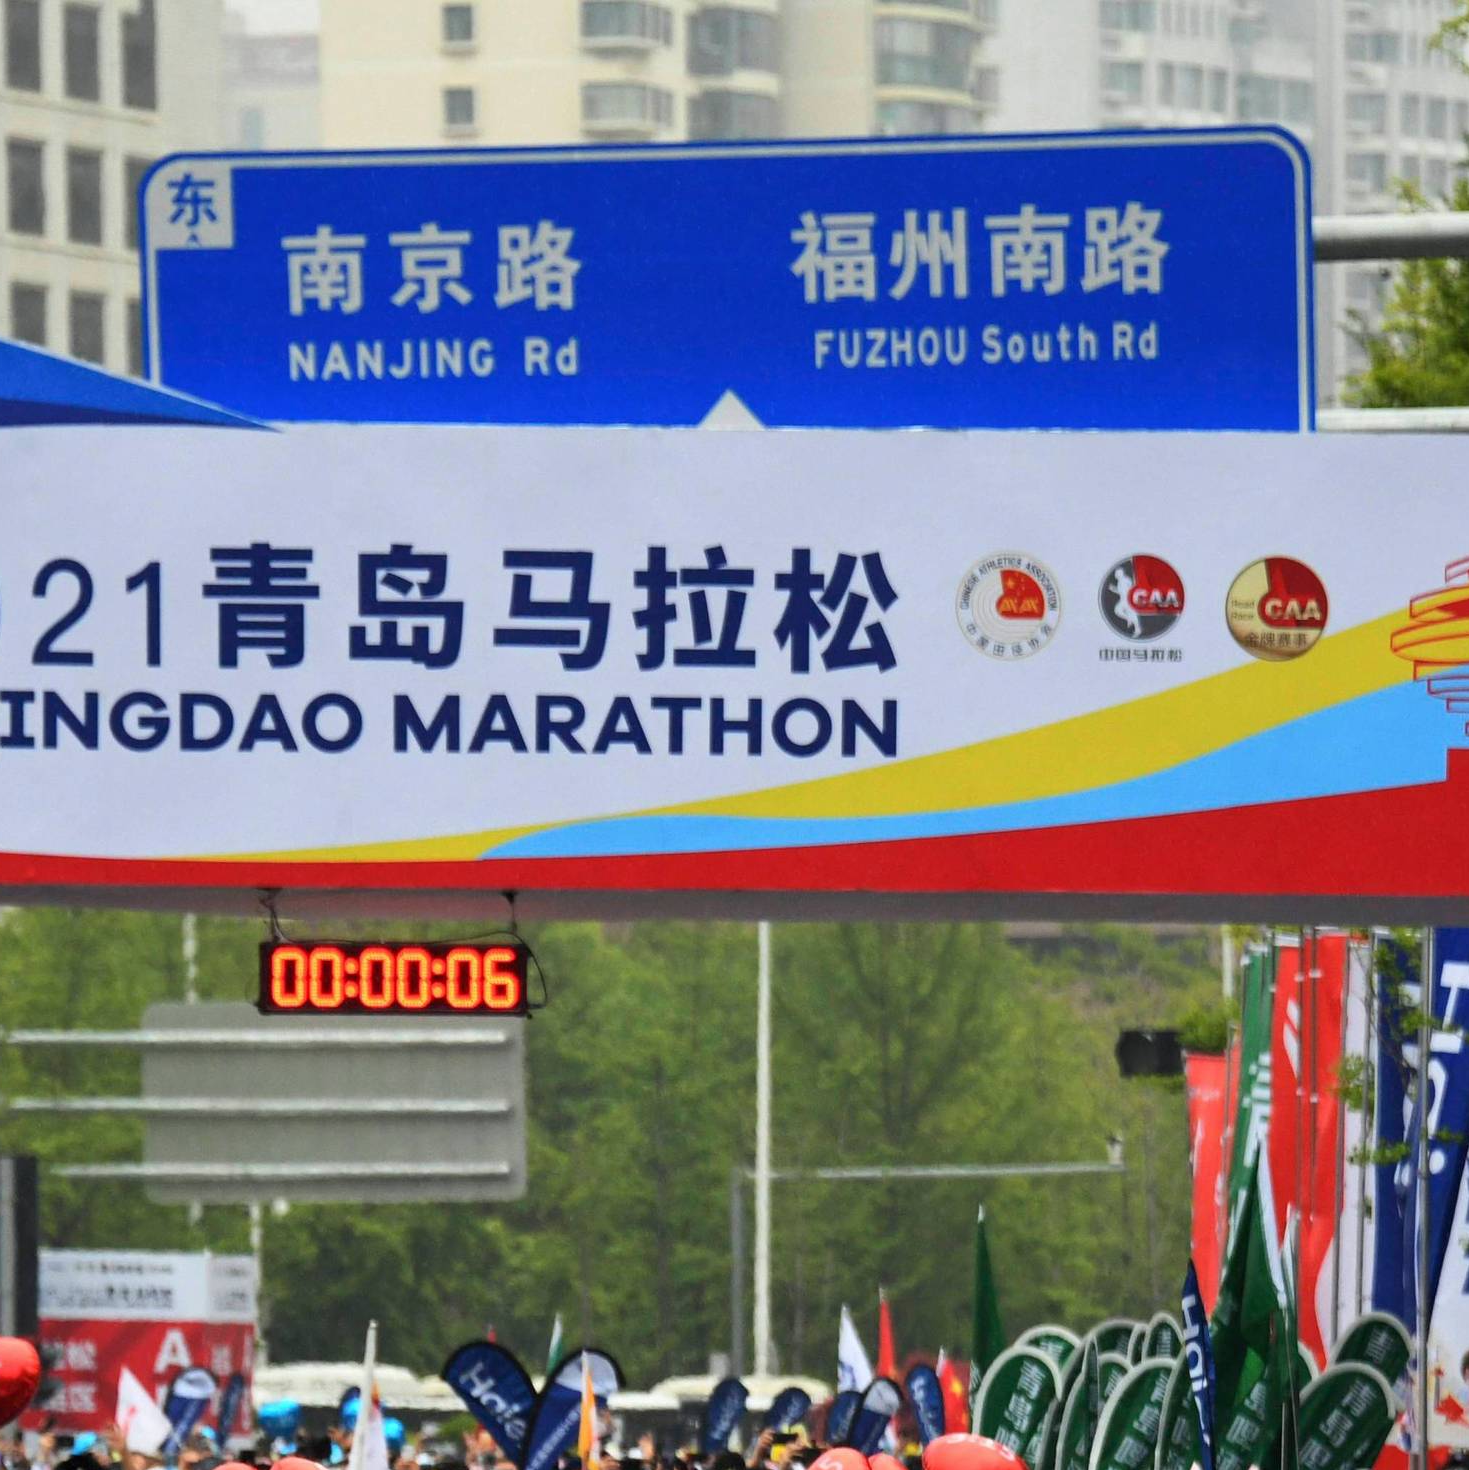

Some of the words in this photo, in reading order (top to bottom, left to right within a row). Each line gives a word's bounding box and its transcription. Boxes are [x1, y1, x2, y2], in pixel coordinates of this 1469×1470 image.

[167, 174, 218, 226] 东
[280, 220, 582, 316] 南京路
[789, 201, 1171, 307] 福州南路
[289, 338, 495, 382] NANJING
[524, 336, 579, 378] Rd
[814, 327, 967, 371] FUZHOU
[981, 322, 1100, 364] South
[1114, 321, 1159, 362] Rd
[1132, 588, 1179, 608] CAA
[1265, 598, 1321, 620] CAA
[392, 693, 898, 758] MARATHON
[272, 946, 521, 1008] 00:00:06
[153, 1328, 193, 1373] A
